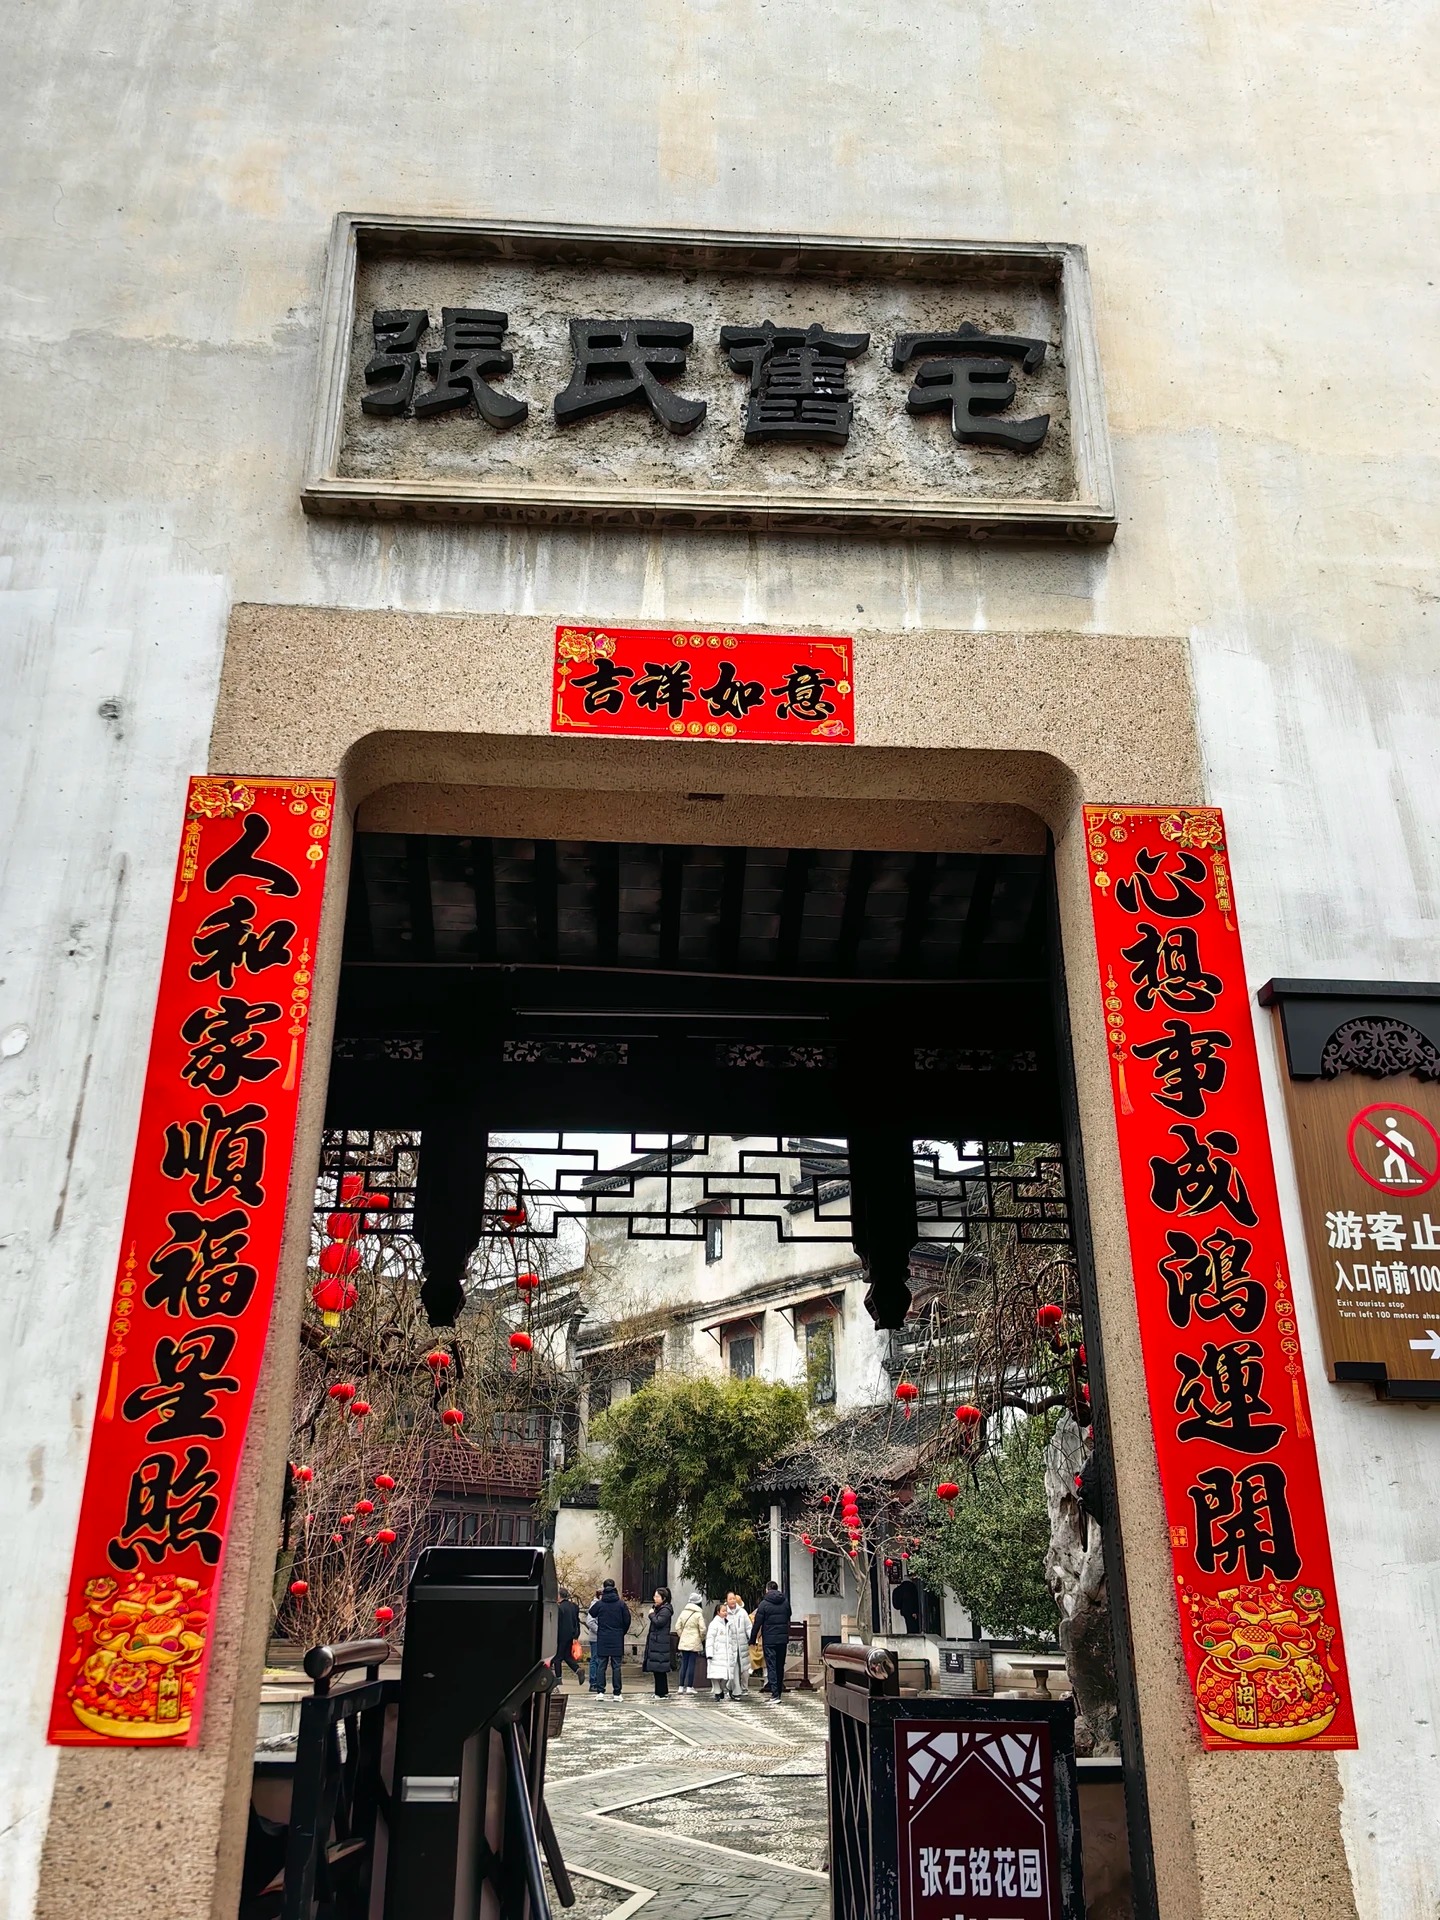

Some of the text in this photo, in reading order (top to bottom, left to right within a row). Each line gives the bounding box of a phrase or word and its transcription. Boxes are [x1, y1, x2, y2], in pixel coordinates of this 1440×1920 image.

[361, 307, 1050, 454] 張氏舊宅
[569, 657, 836, 721] 吉祥如意
[107, 812, 301, 1572] 人和家順福星照
[1115, 847, 1303, 1581] 心想事成鴻運開
[1325, 1210, 1440, 1251] 游客止
[1337, 1299, 1405, 1309] Exit tourists stop
[1339, 1310, 1356, 1318] Turn
[1236, 1685, 1255, 1724] 招财
[919, 1847, 1042, 1898] 张石铭花园
